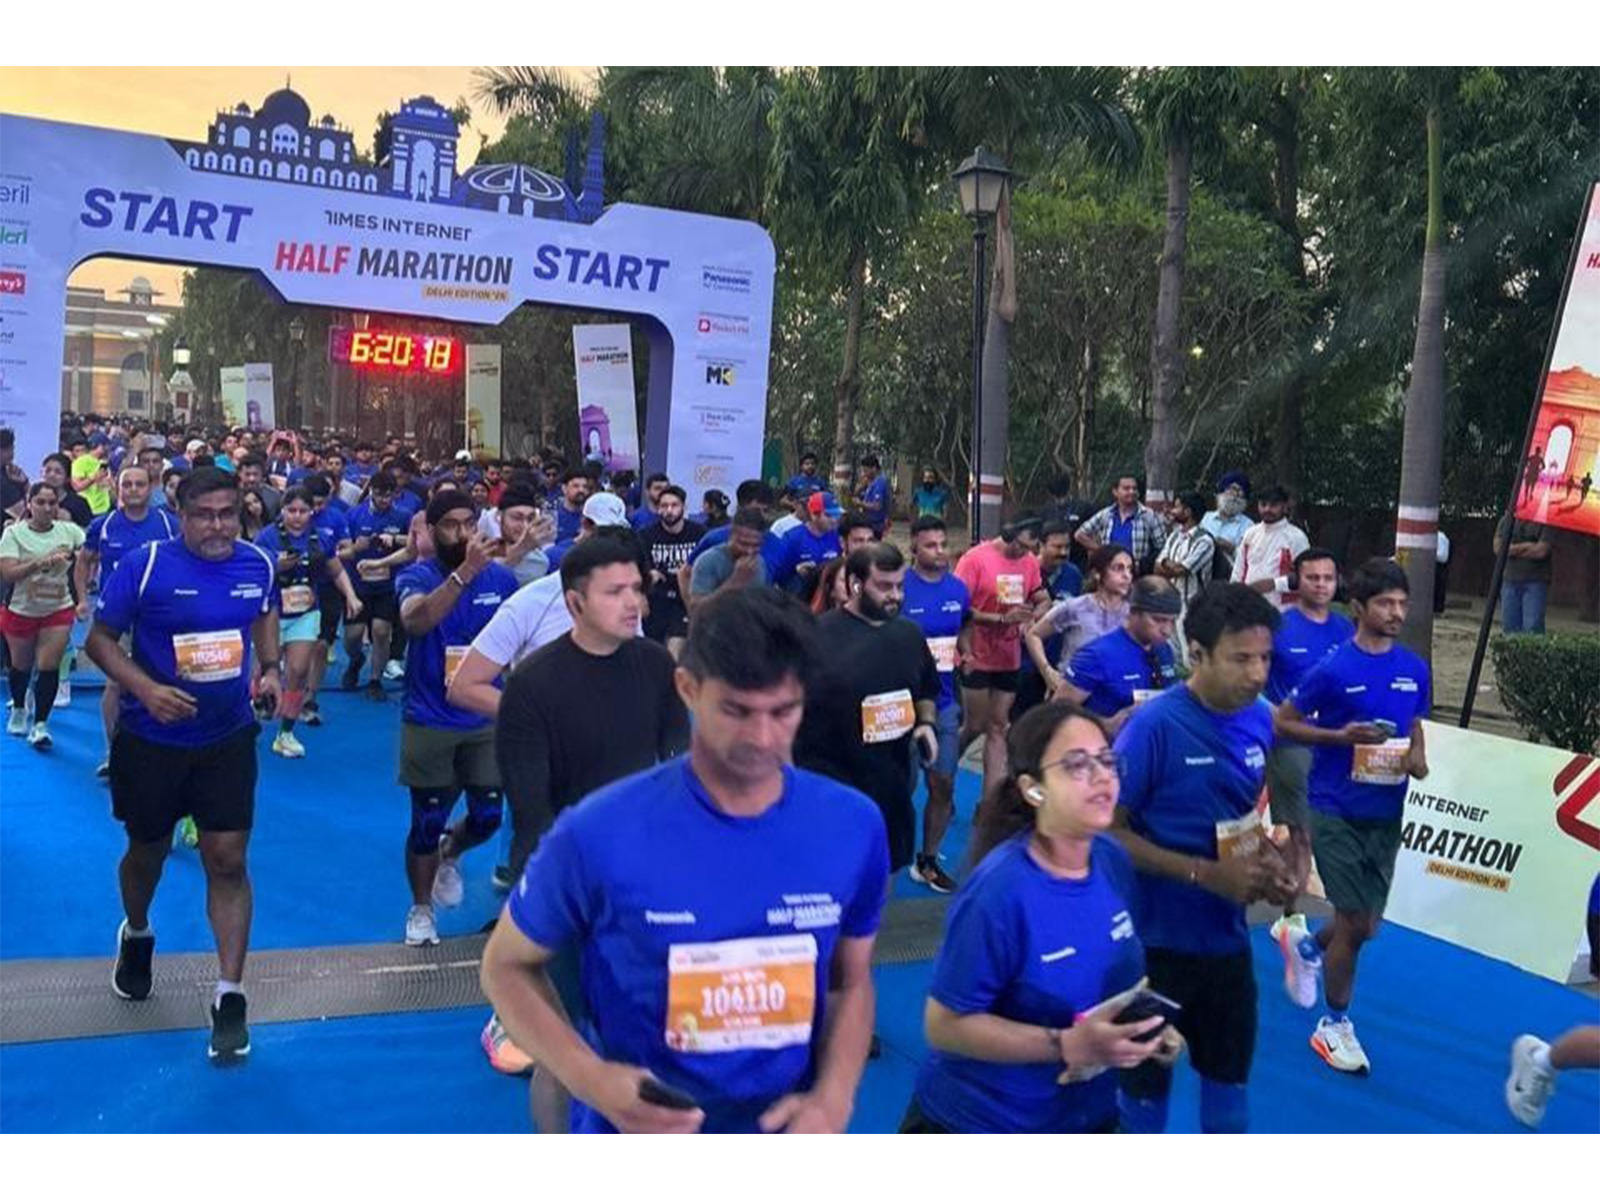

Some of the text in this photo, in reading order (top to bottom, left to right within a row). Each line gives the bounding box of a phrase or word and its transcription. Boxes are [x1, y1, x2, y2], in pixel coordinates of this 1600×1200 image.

[80, 187, 253, 243] START
[275, 241, 512, 284] HALF MARATHON
[534, 244, 670, 292] START
[1408, 790, 1489, 822] INTERNET
[1401, 822, 1523, 873] ARATHON
